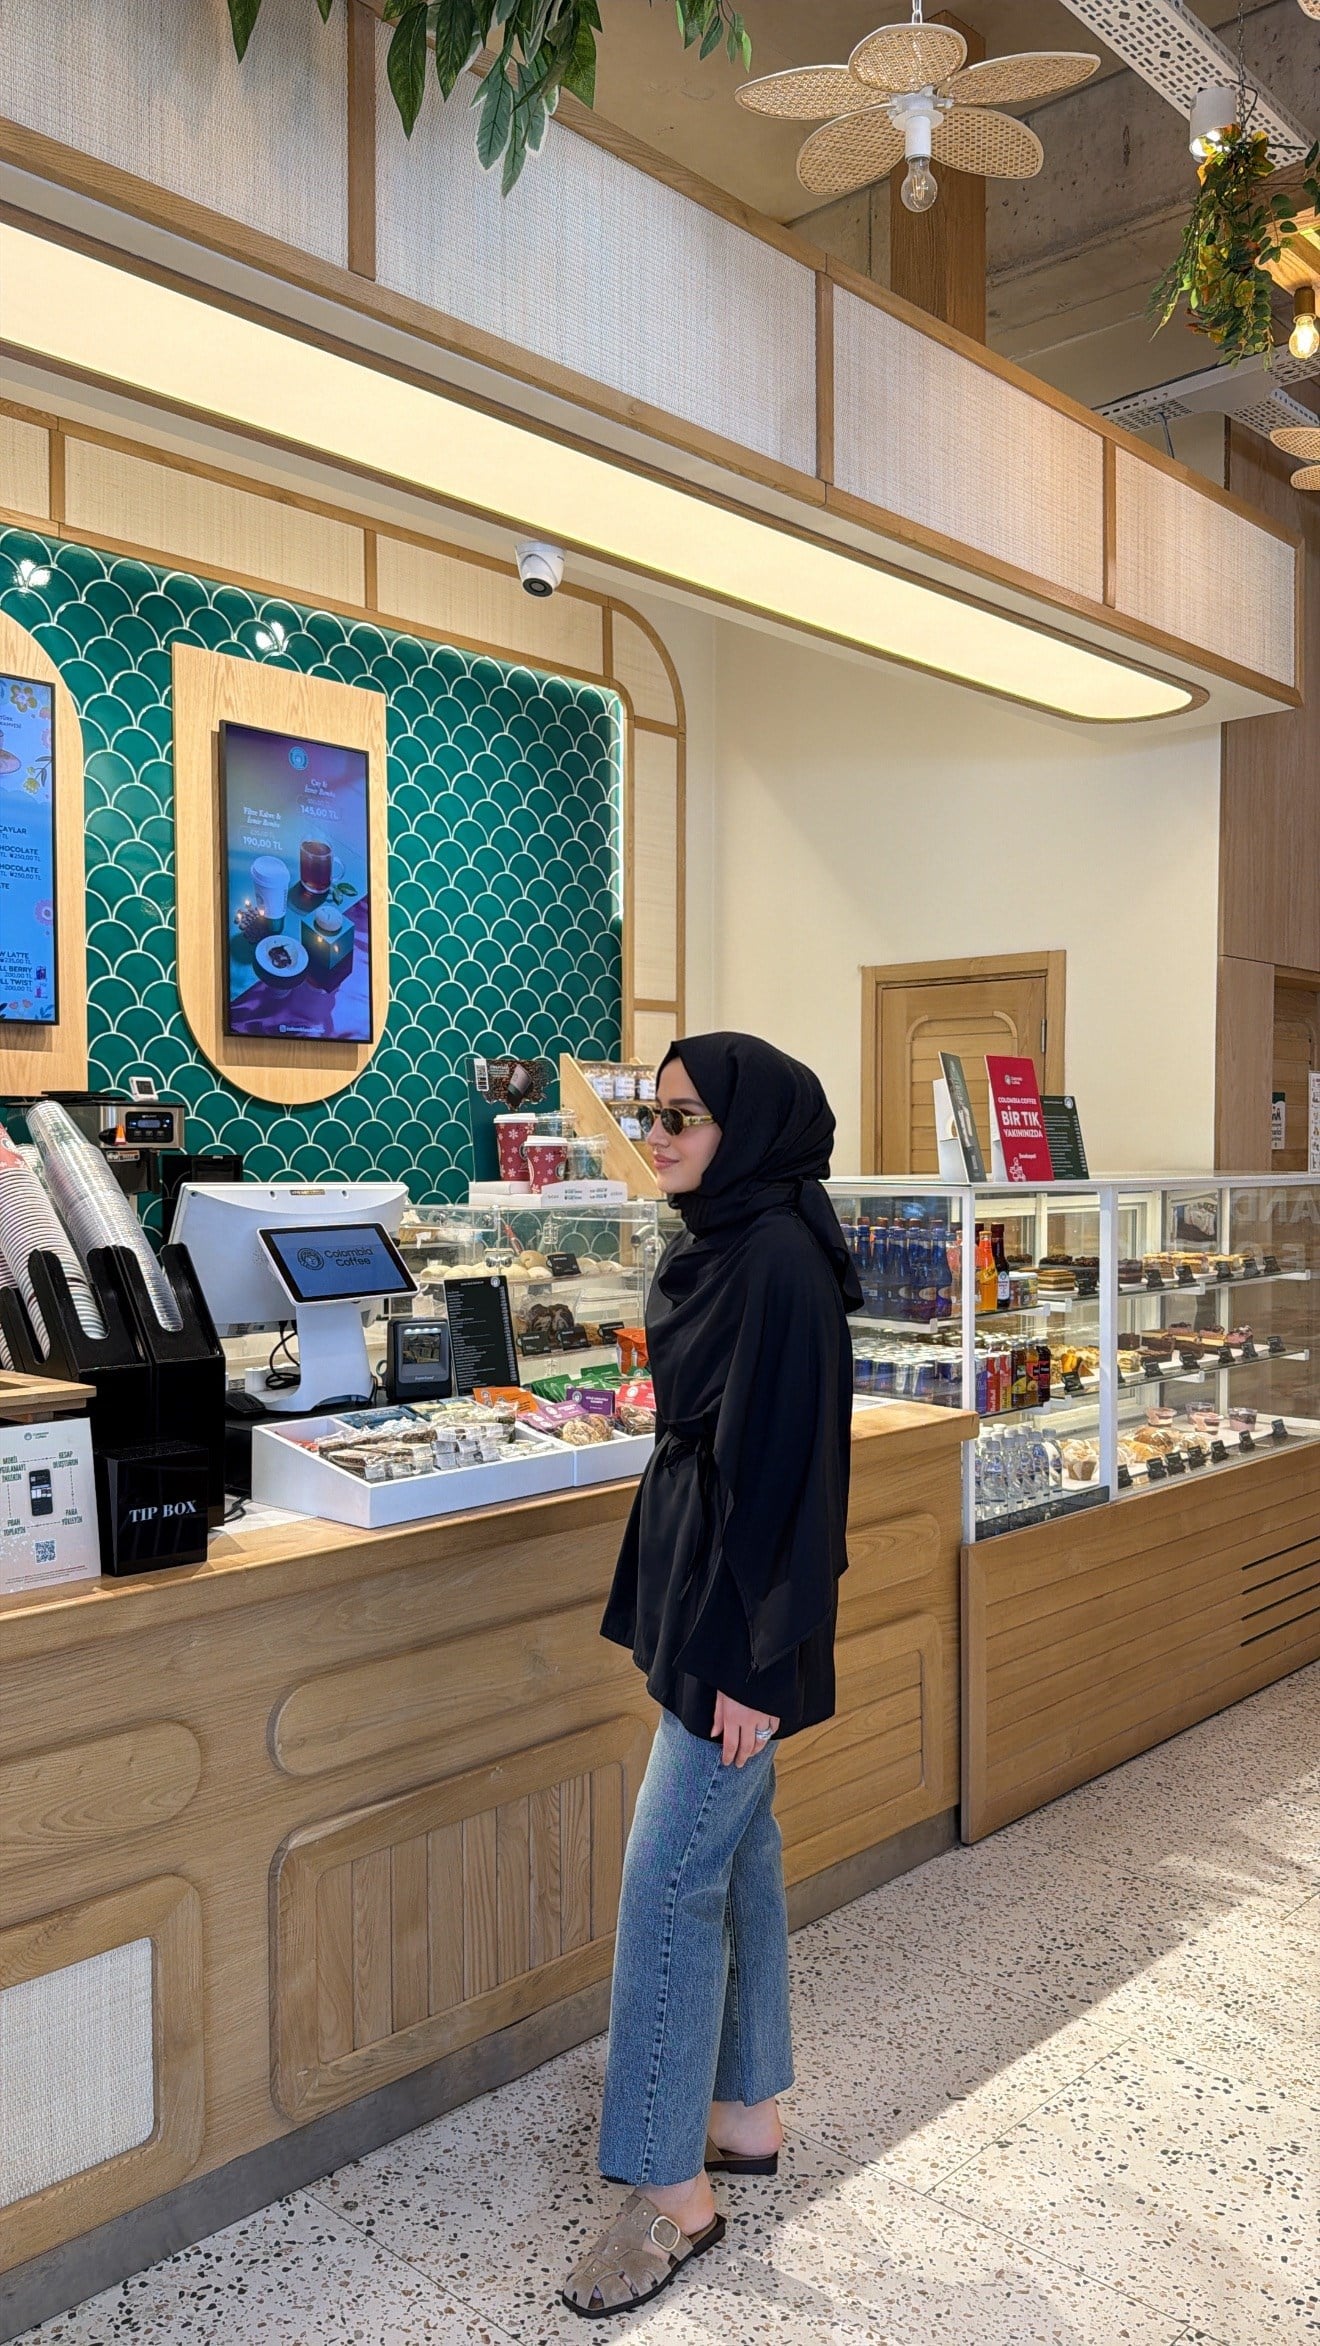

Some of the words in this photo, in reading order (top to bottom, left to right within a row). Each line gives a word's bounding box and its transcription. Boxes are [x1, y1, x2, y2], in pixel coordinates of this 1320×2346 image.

[300, 805, 328, 817] 145,00
[329, 810, 339, 820] TL
[243, 836, 272, 848] 190,00
[273, 841, 282, 850] TL
[0, 845, 39, 855] HOCOLATE
[0, 863, 39, 874] HOCOLATE
[8, 965, 33, 973] BERRY
[1000, 1105, 1021, 1126] BİR
[1003, 1128, 1044, 1138] YAKININIZDA
[323, 1247, 374, 1258] Colombia
[335, 1257, 371, 1267] Coffee
[128, 1505, 158, 1523] TIP
[162, 1499, 197, 1518] BOX
